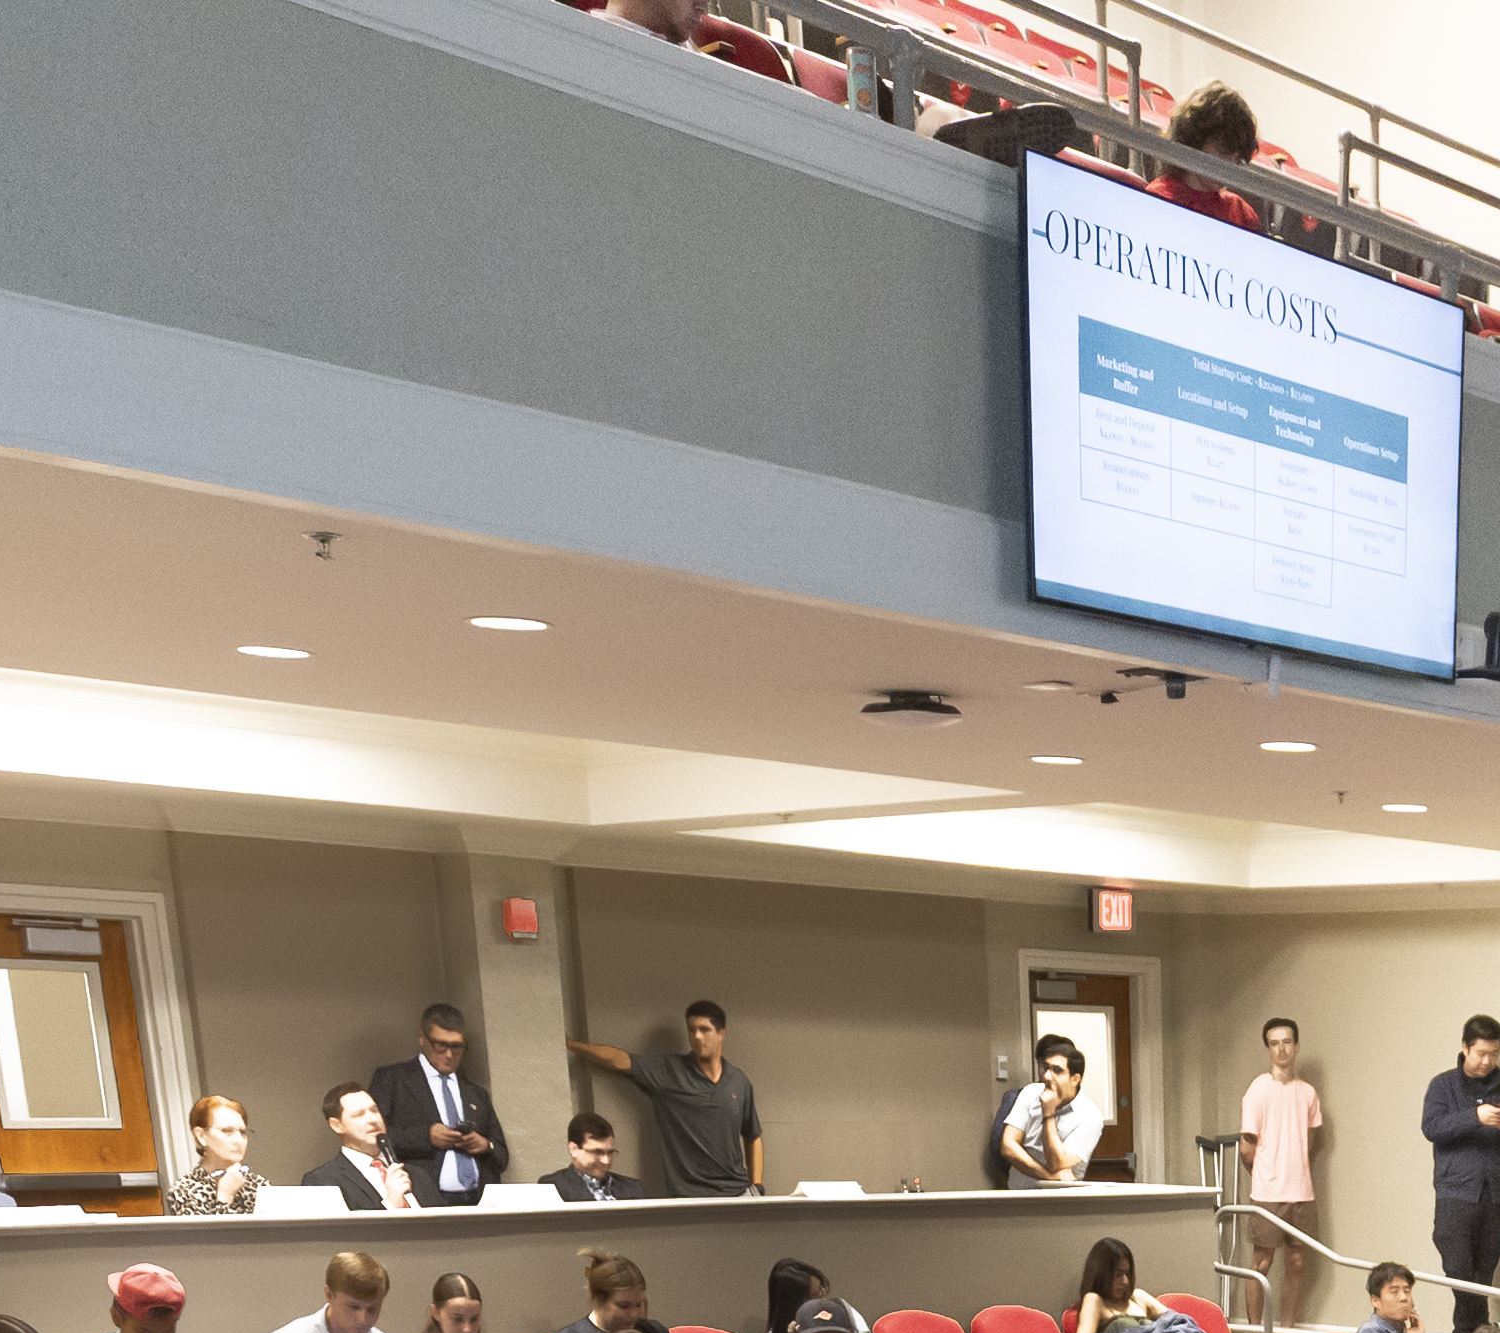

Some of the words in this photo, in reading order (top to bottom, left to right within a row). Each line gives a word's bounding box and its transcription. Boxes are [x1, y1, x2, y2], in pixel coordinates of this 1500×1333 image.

[1044, 210, 1234, 310] OPERATING
[1245, 278, 1338, 345] COSTS
[1096, 353, 1137, 379] Marketing
[1138, 365, 1154, 382] and
[1113, 377, 1139, 396] Buffer
[1177, 386, 1212, 408] Locations
[1212, 397, 1227, 412] and
[1228, 402, 1248, 420] Setup
[1095, 407, 1112, 422] Rent
[1113, 411, 1127, 426] and
[1268, 404, 1306, 427] Equipment
[1306, 416, 1320, 430] and
[1275, 424, 1314, 447] Technology
[1343, 435, 1379, 457] Operations
[1100, 892, 1132, 930] EXIT
